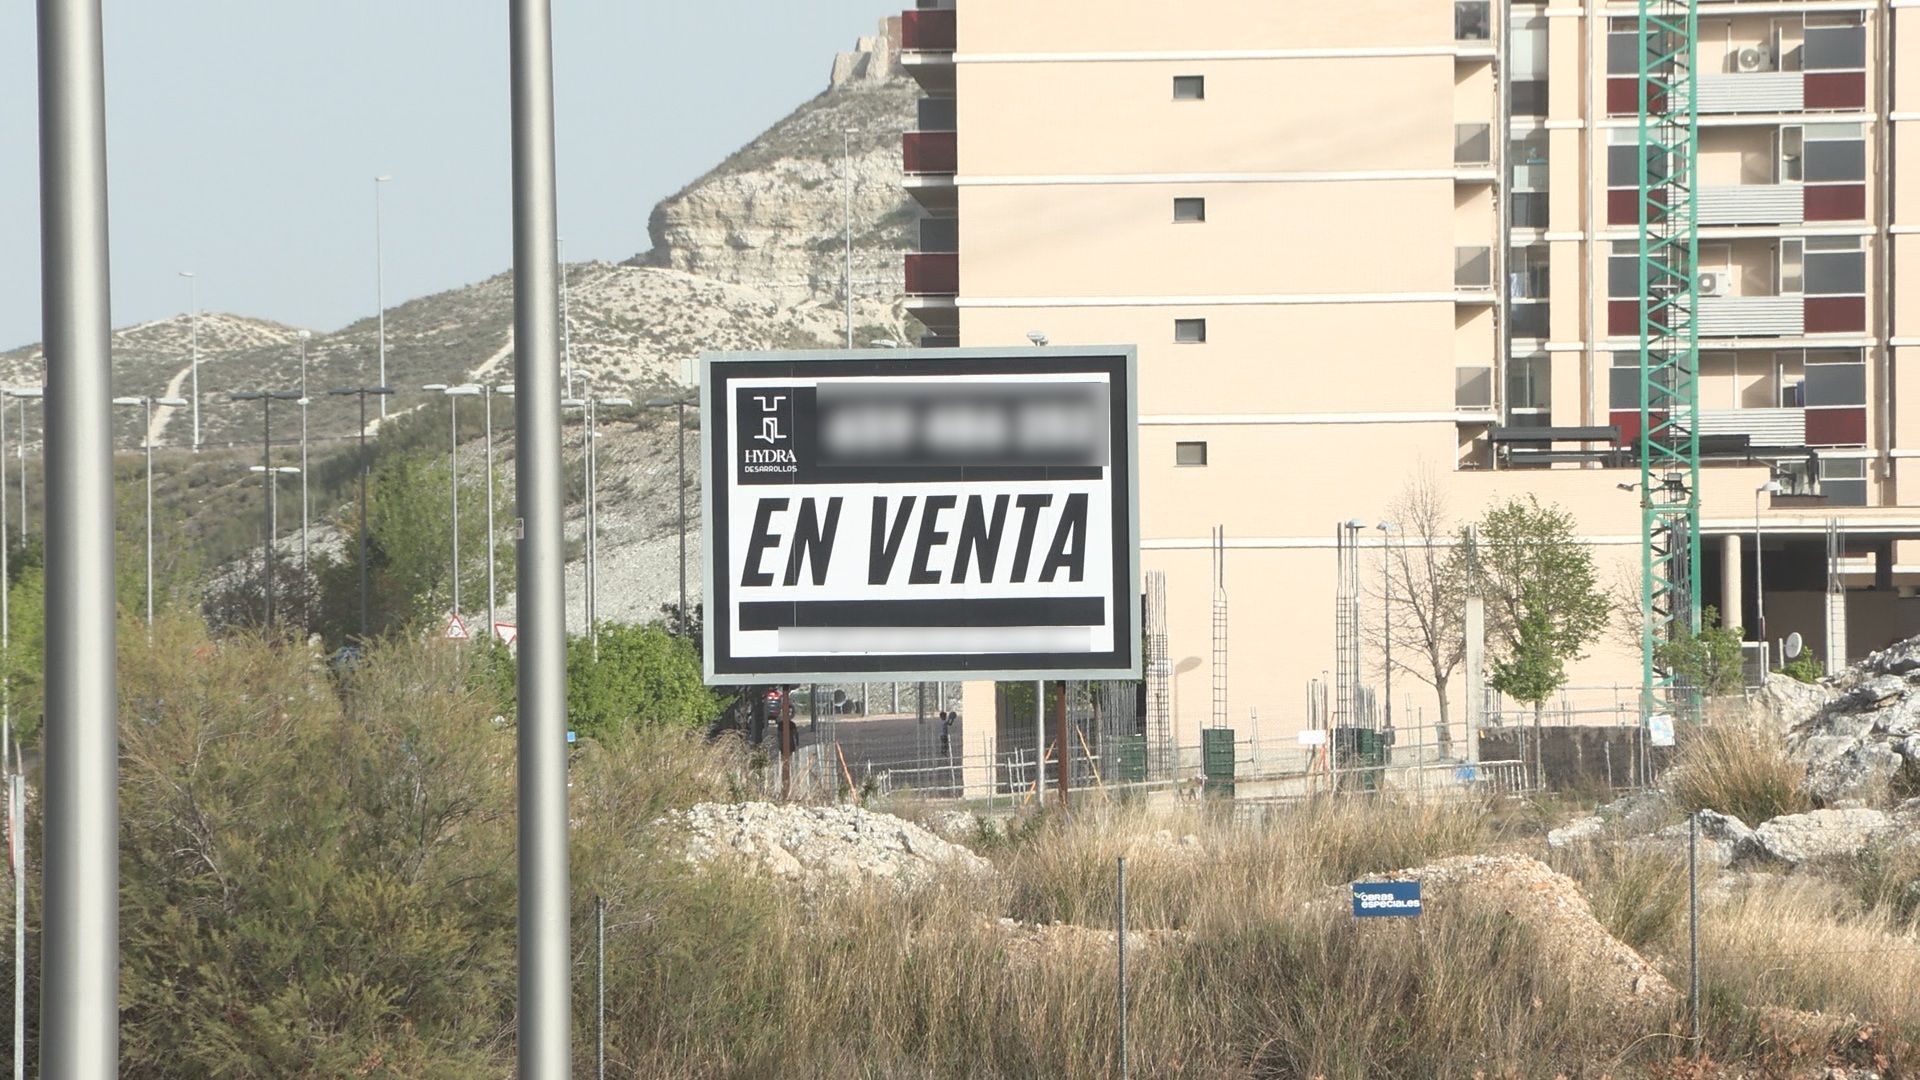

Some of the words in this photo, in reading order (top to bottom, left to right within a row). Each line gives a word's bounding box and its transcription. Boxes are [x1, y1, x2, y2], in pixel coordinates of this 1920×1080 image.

[745, 449, 797, 463] HYDRA
[740, 496, 844, 588] EN
[867, 493, 1090, 586] VENTA
